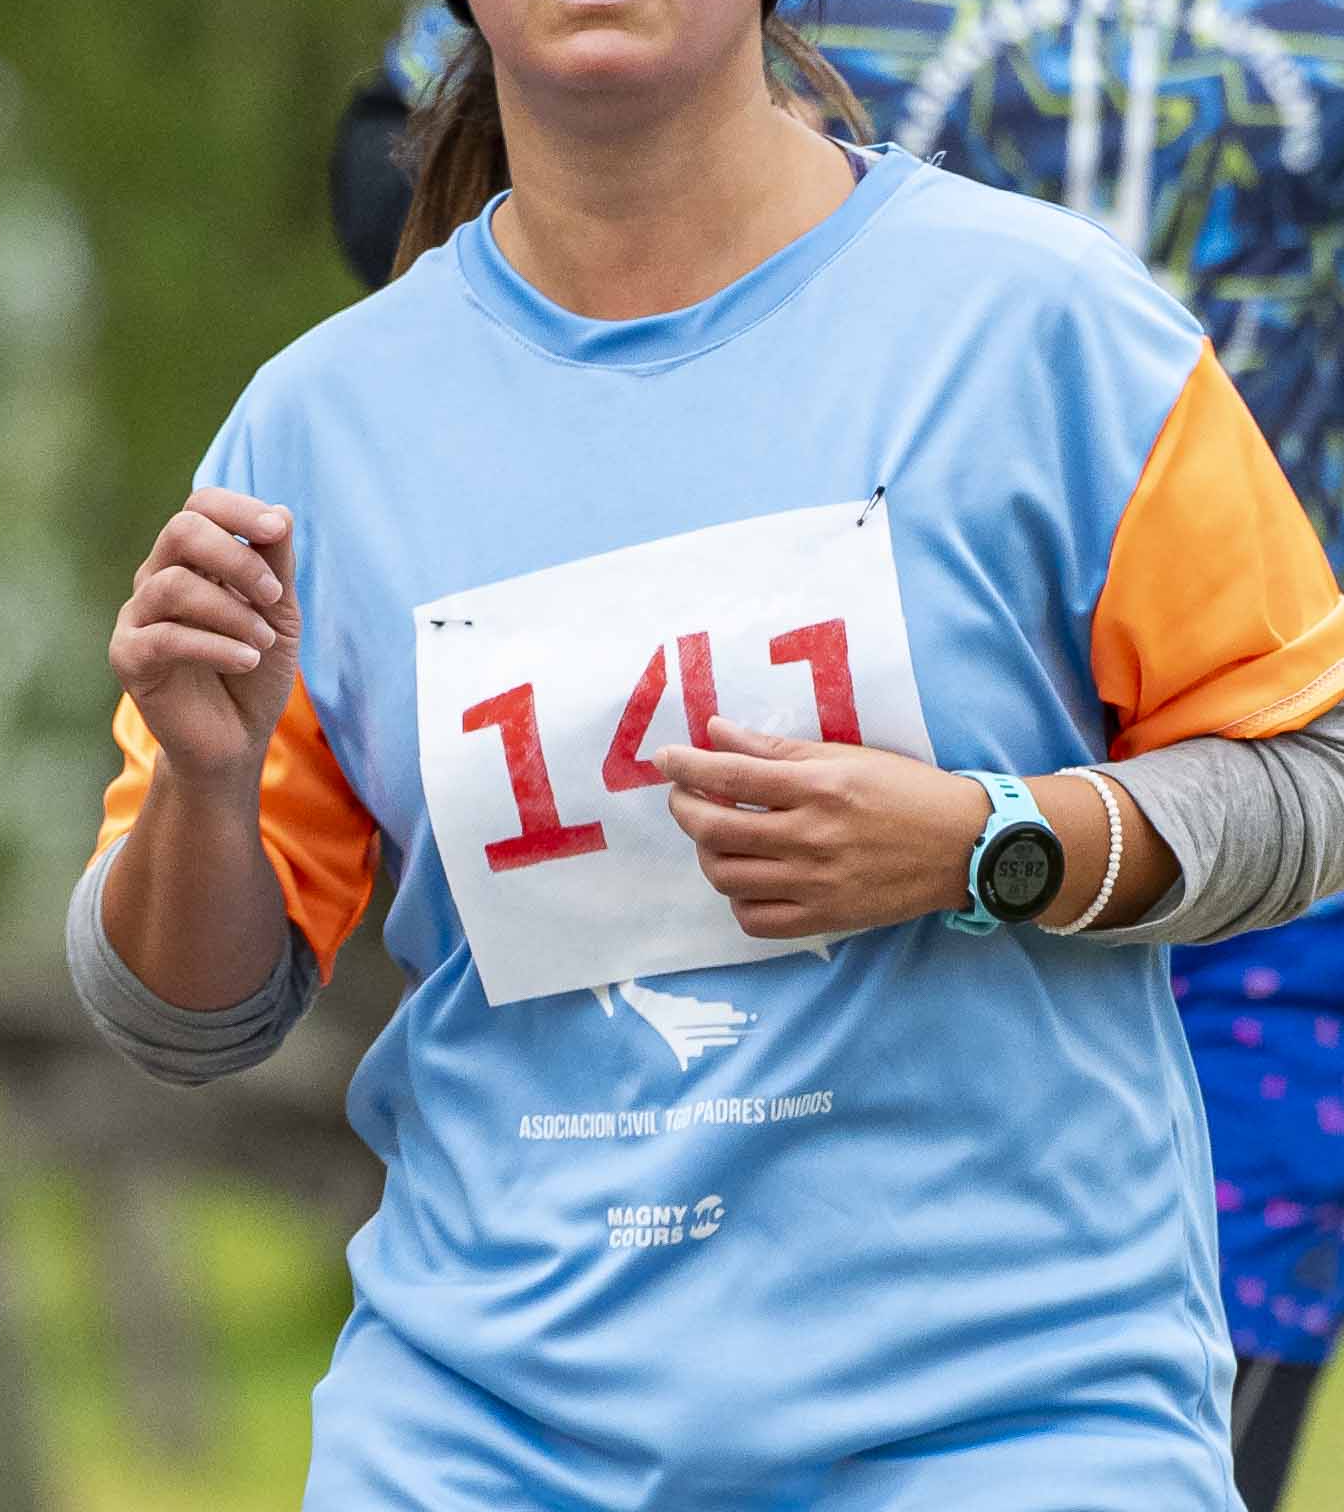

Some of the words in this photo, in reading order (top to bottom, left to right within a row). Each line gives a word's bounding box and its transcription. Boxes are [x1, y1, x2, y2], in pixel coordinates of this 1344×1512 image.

[461, 617, 863, 874] 141
[519, 1113, 616, 1140] ASOCIACION
[617, 1110, 659, 1137] CIVIL
[692, 1097, 765, 1126] PADRES
[769, 1090, 834, 1122] UNIDOS
[607, 1205, 688, 1226] MAGNY
[609, 1226, 684, 1248] COURS
